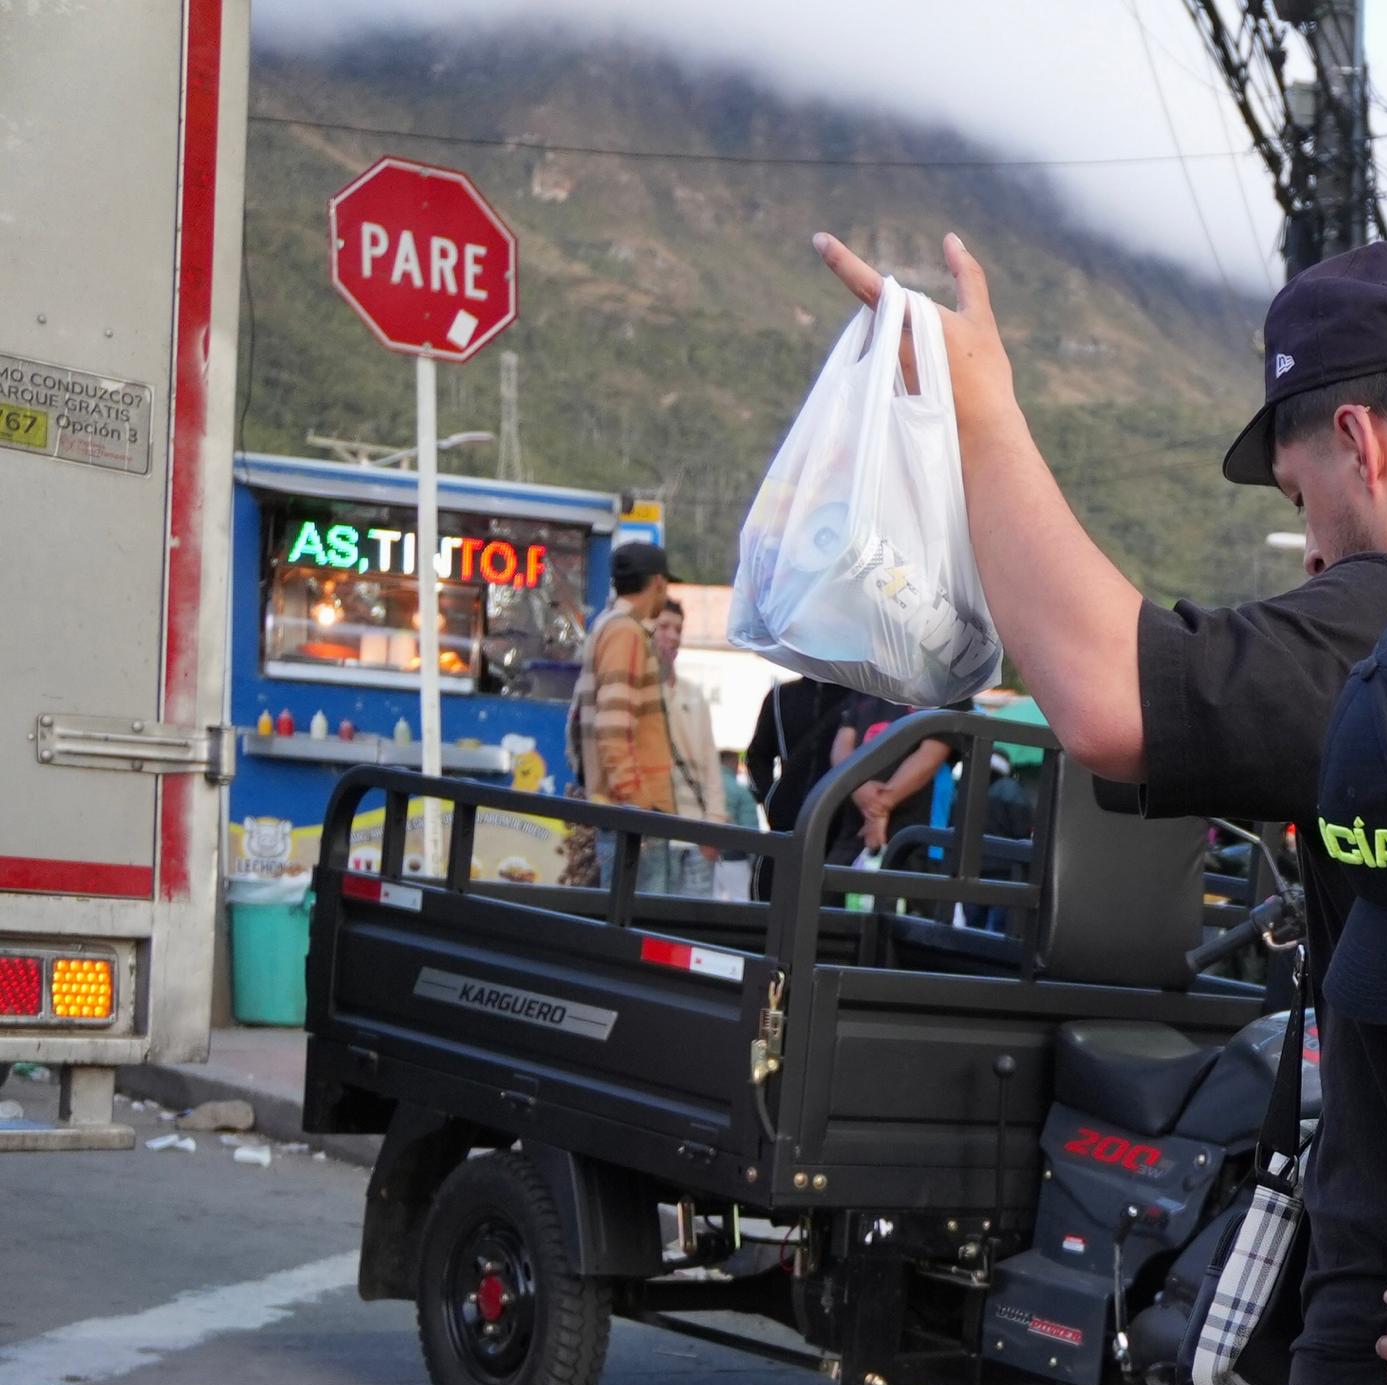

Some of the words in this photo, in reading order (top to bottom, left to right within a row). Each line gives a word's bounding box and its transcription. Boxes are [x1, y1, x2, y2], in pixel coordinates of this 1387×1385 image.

[361, 221, 489, 301] PARE
[30, 372, 143, 409] CONDUZCO?
[0, 408, 38, 434] 67
[56, 414, 121, 442] Opción
[128, 428, 139, 444] 3
[65, 398, 131, 423] GRATIS
[459, 983, 567, 1025] KARGUERO
[1063, 1126, 1162, 1171] 200
